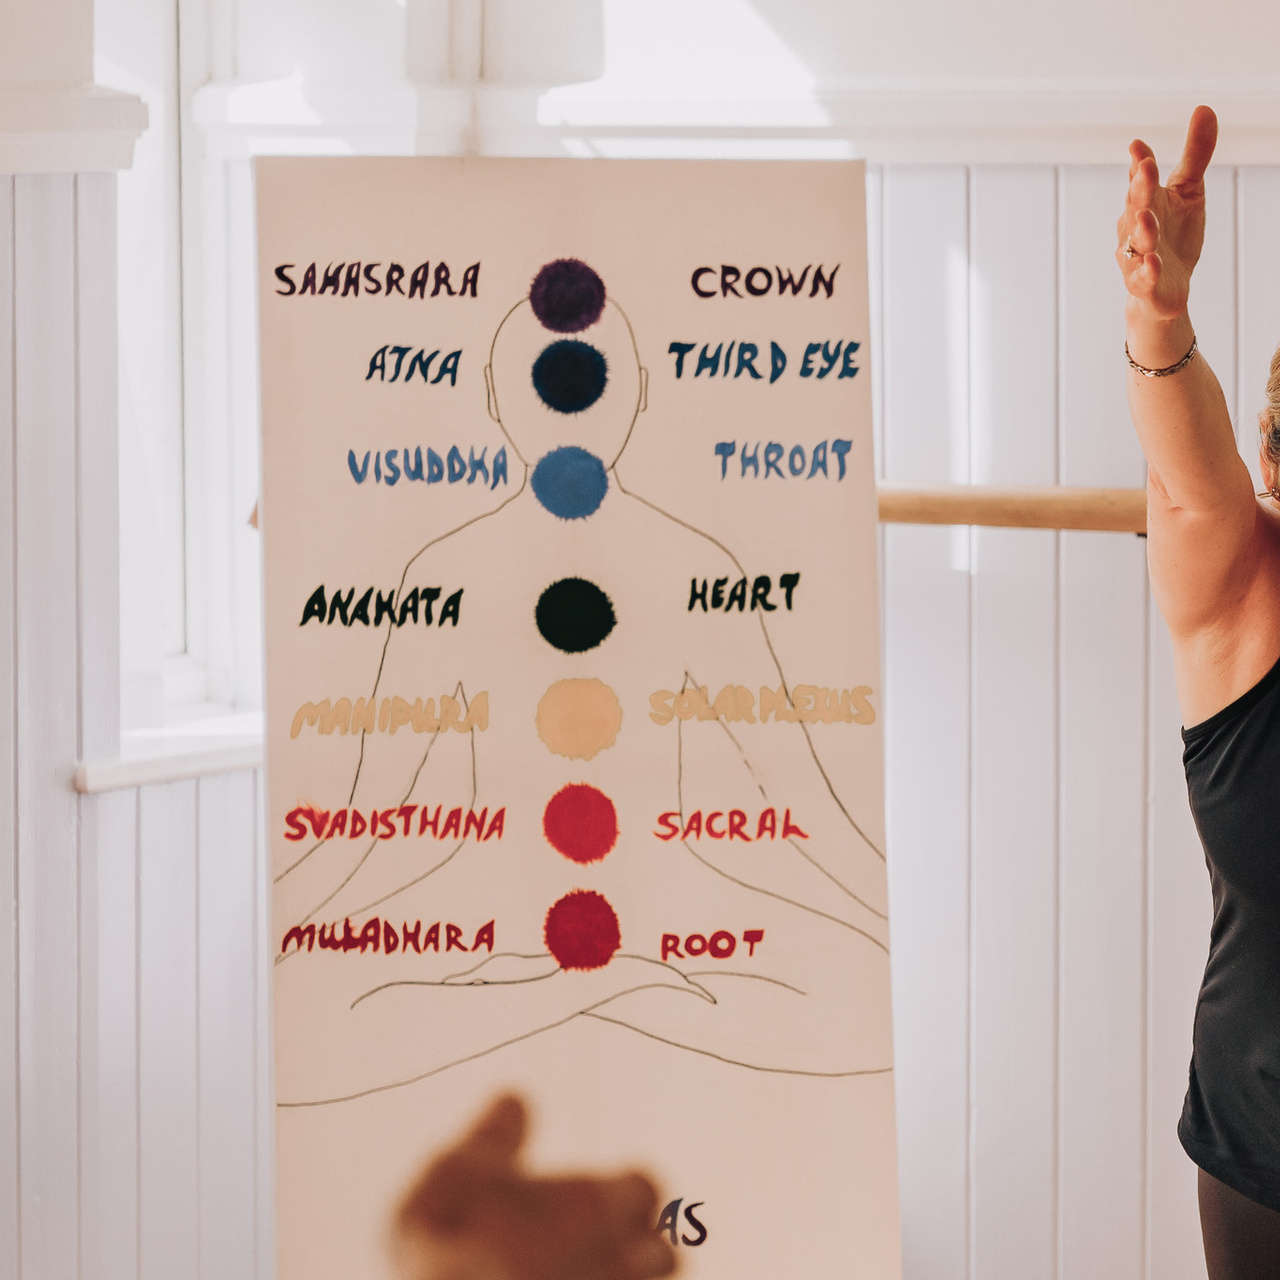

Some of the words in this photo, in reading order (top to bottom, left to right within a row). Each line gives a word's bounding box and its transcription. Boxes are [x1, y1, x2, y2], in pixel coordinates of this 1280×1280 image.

[274, 261, 480, 300] SAHASRARA
[691, 264, 841, 299] CROWN
[668, 340, 787, 384] THIRD
[799, 340, 862, 379] EYE
[348, 445, 508, 490] VISUDDHA
[714, 439, 853, 481] THROAT
[299, 584, 464, 627] ANAHATA
[688, 572, 801, 613] HEART
[648, 684, 757, 726] SOLAR
[283, 805, 507, 842] SVADISTHANA
[653, 808, 809, 842] SACRAL
[661, 930, 765, 961] ROOT
